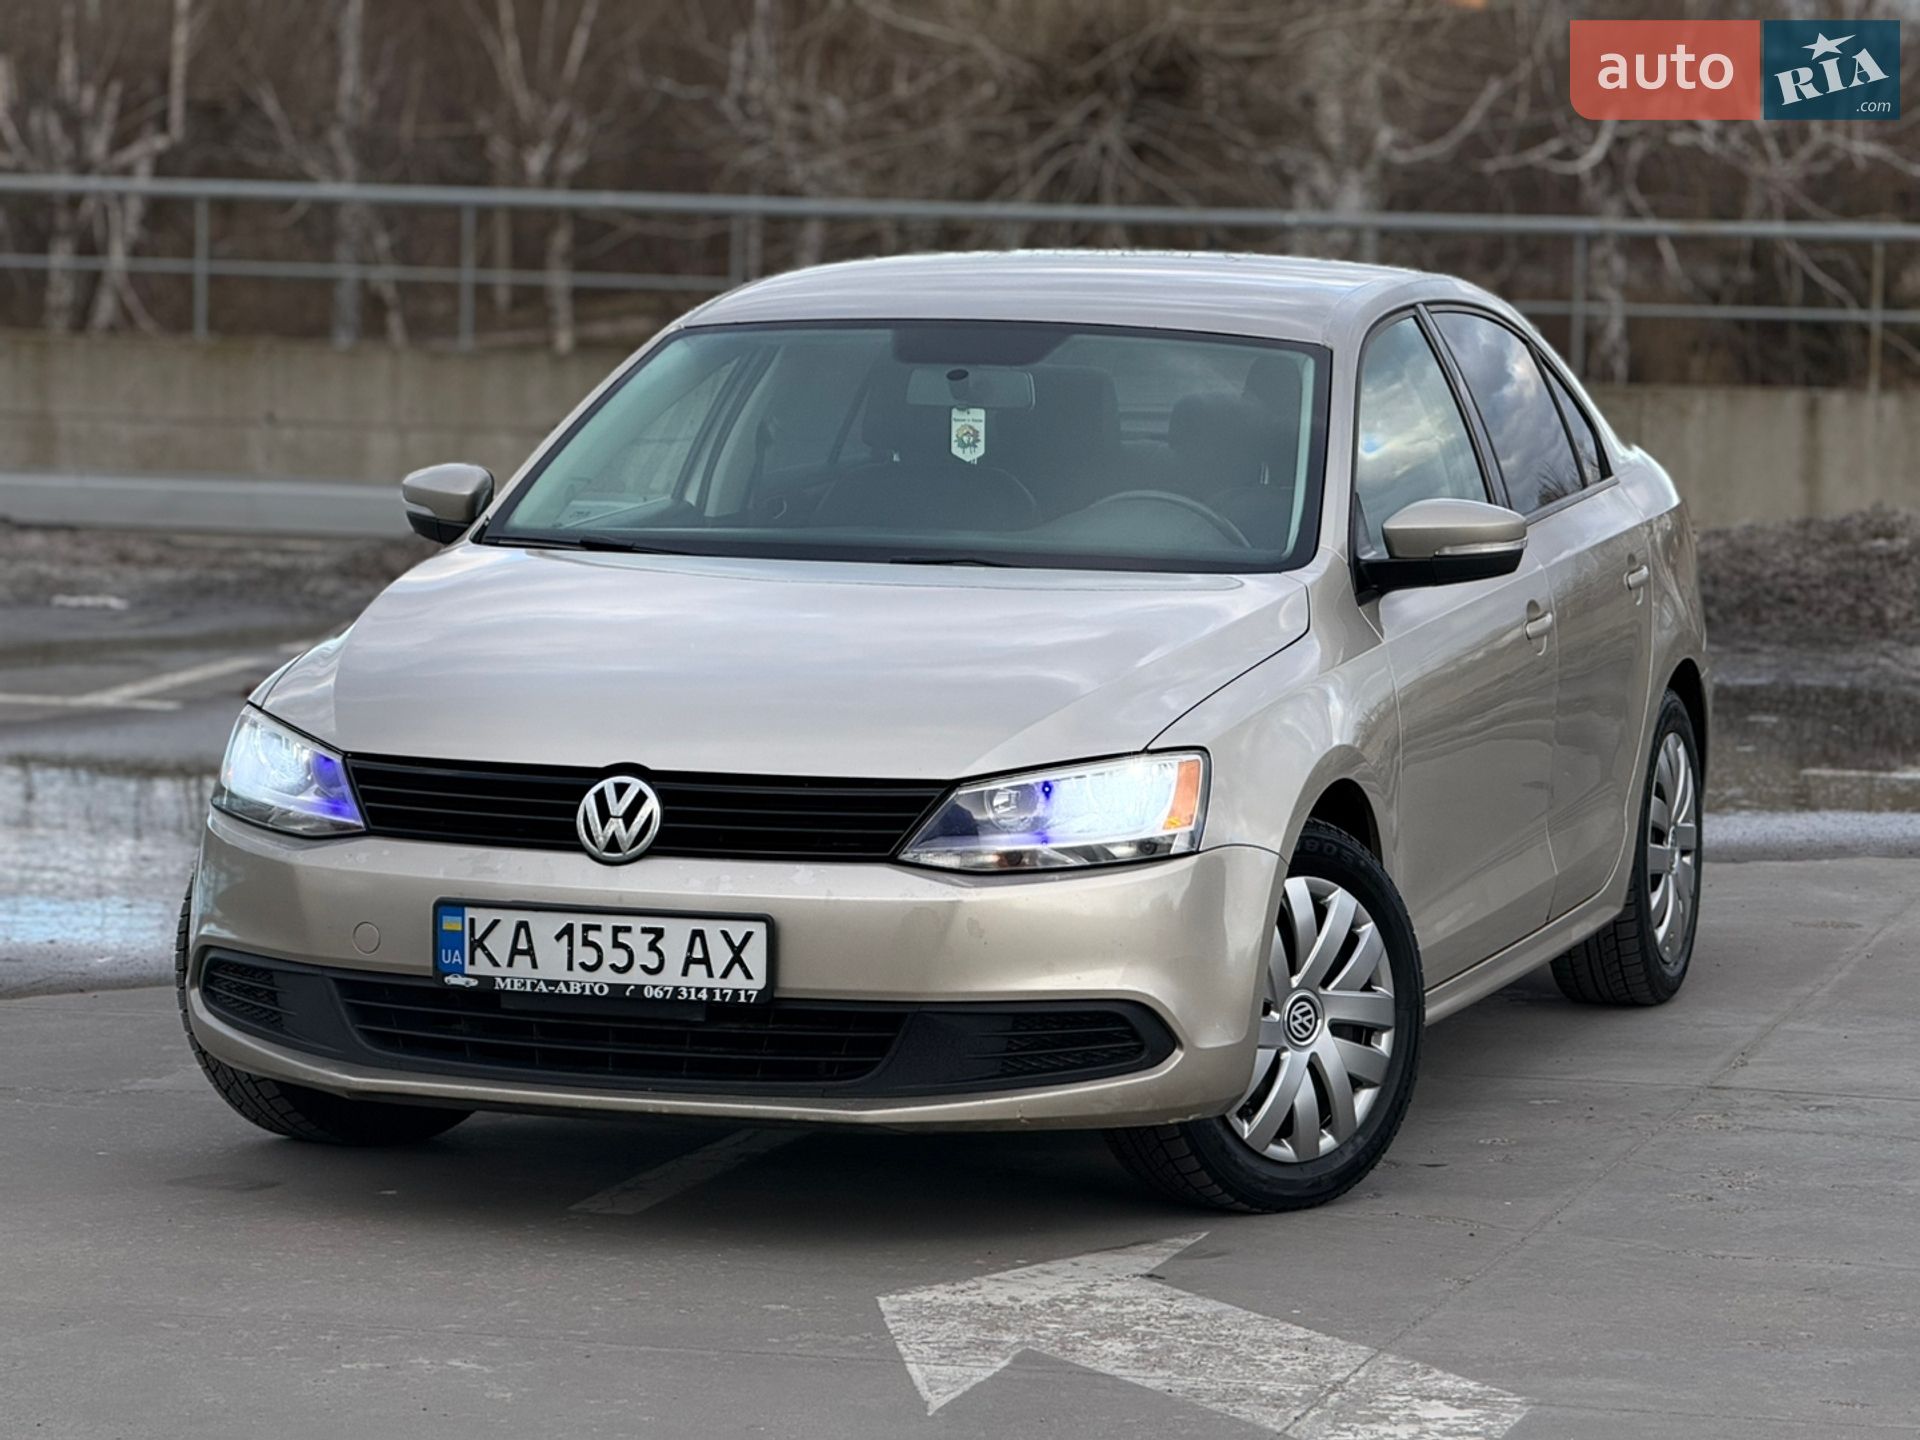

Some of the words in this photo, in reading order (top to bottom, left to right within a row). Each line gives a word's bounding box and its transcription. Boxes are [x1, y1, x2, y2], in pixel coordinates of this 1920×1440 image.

[442, 949, 462, 965] UA
[469, 917, 538, 970] KA
[554, 922, 665, 976] 1553
[681, 929, 755, 981] AX
[494, 977, 609, 996] МЕГА-АВТО
[643, 985, 674, 999] 067
[677, 987, 708, 1000] 314
[713, 989, 733, 1002] 17
[737, 990, 758, 1003] 17
